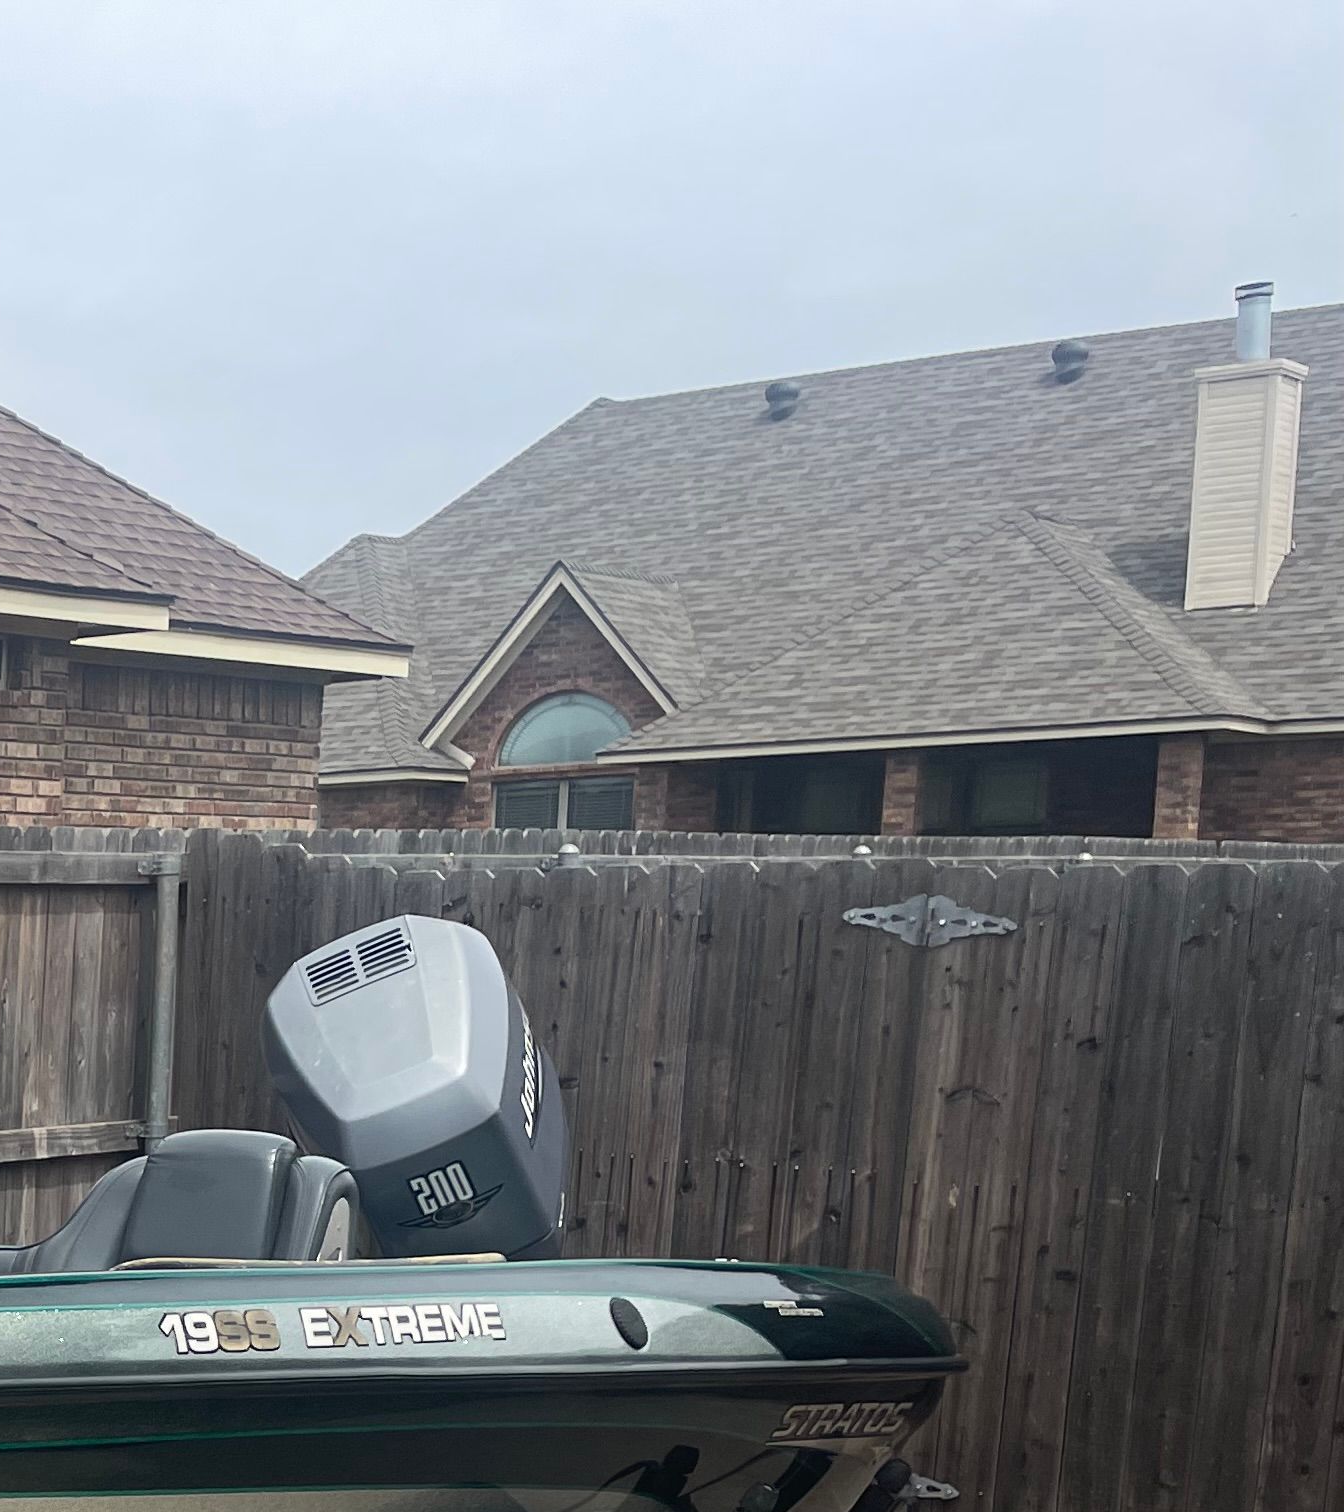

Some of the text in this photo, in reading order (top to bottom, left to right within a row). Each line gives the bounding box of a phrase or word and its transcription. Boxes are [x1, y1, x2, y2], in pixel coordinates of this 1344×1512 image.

[409, 1161, 474, 1216] 200
[299, 1303, 507, 1348] EXTREME
[771, 1402, 914, 1437] STRATOS
